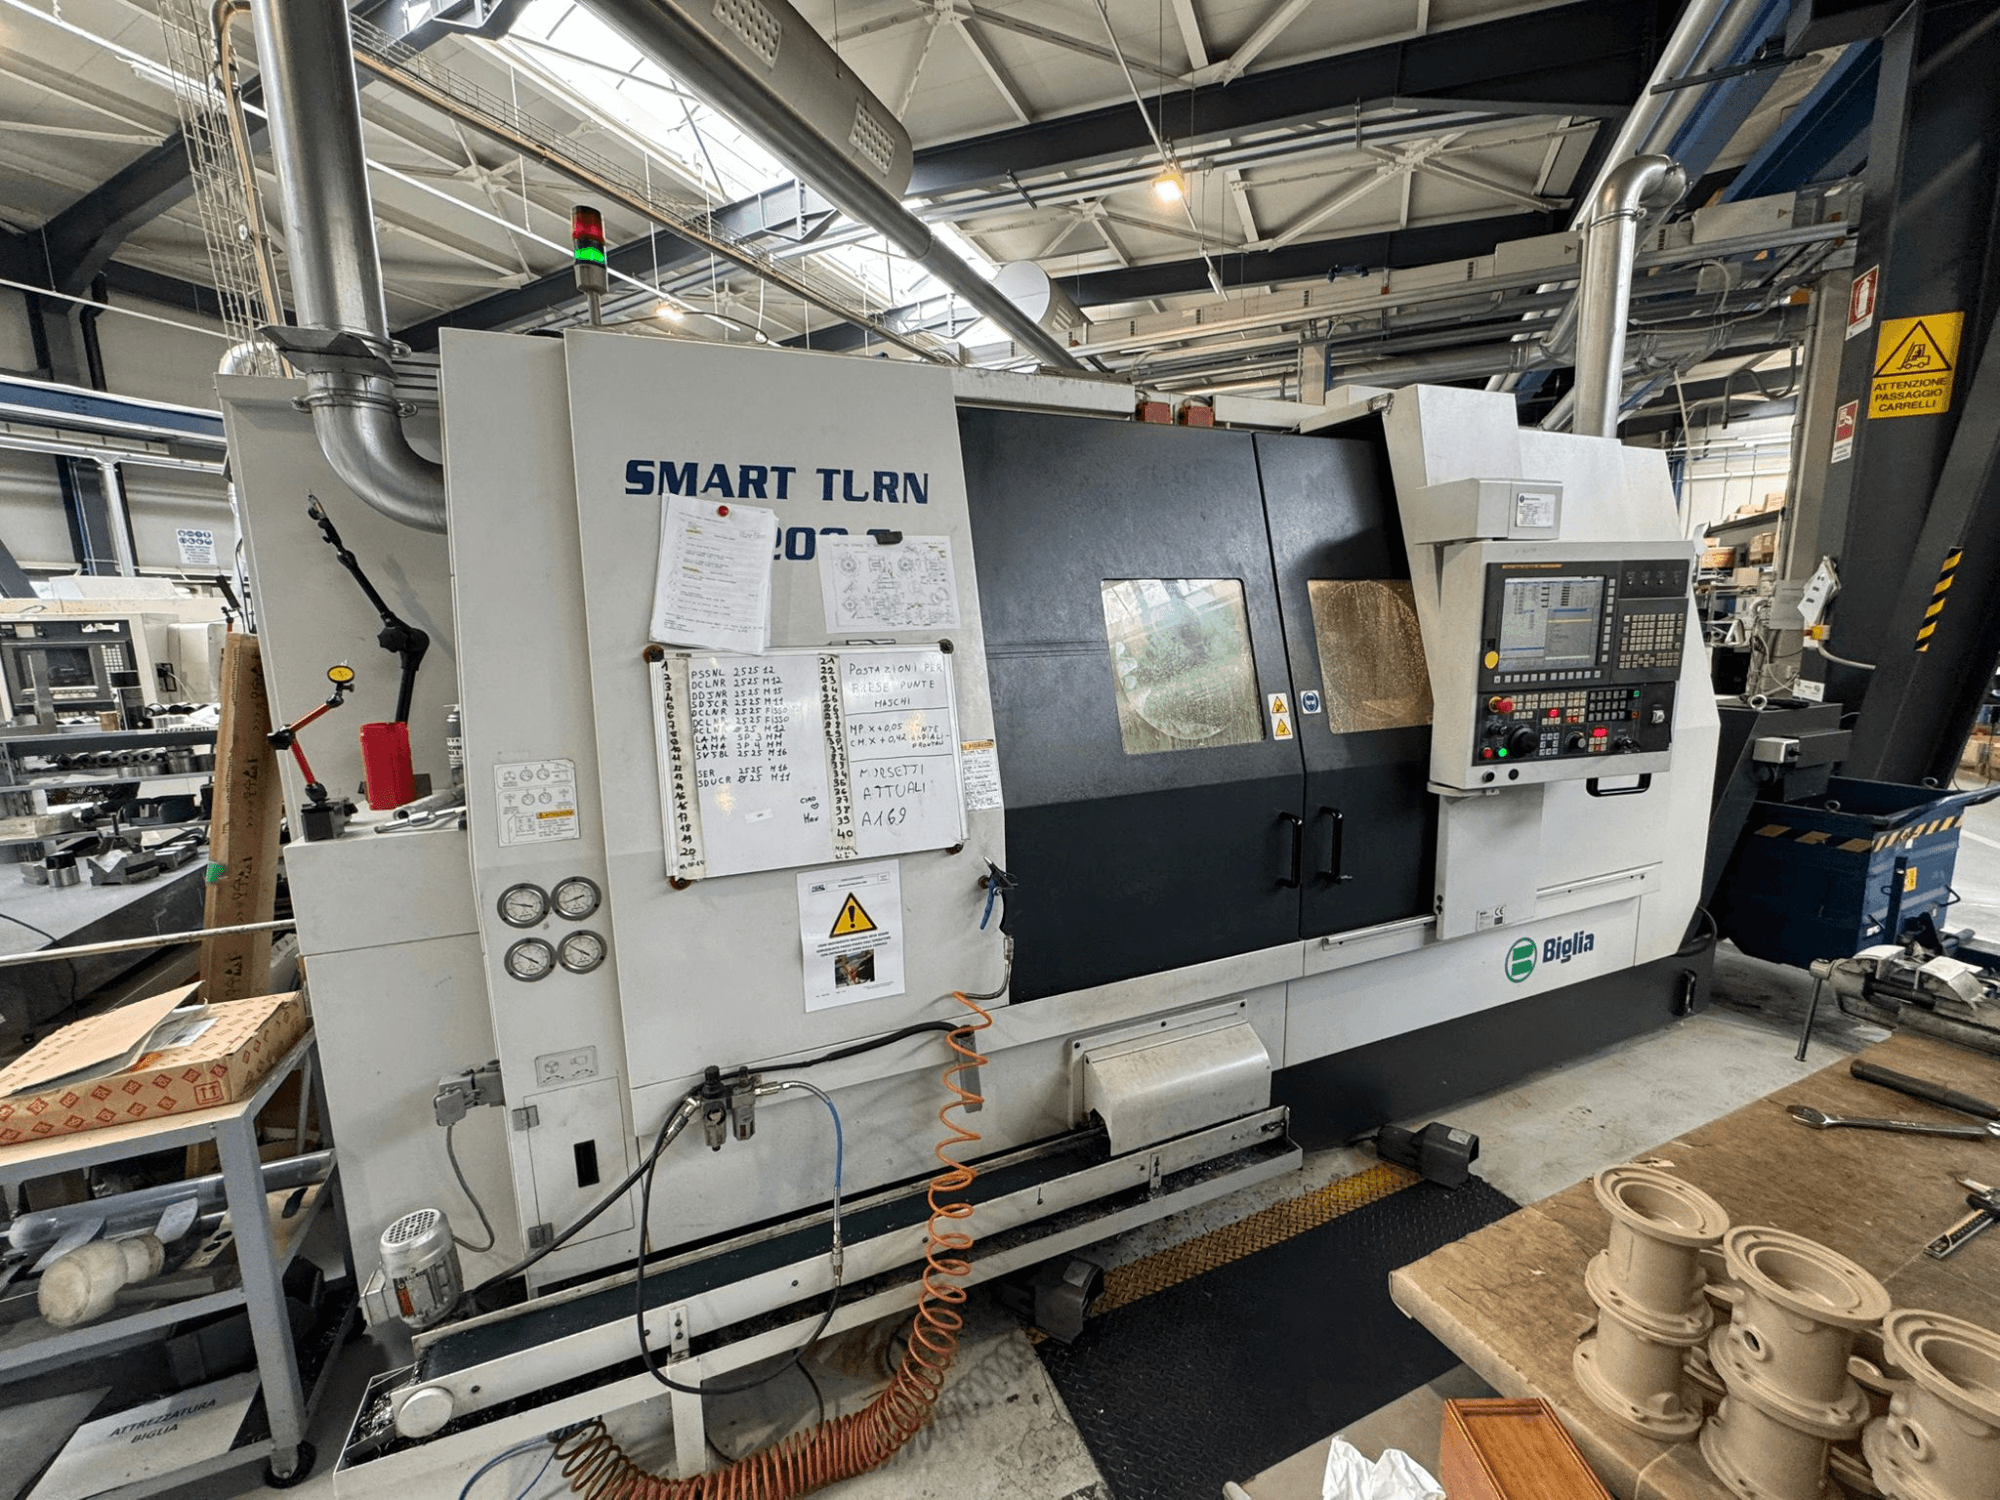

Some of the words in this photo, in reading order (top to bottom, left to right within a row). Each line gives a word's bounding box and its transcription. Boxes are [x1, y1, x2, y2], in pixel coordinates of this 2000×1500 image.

[1874, 377, 1947, 391] ATTENZIONE
[1875, 388, 1943, 401] PASSAGGIO
[1878, 400, 1936, 412] CARRELLI
[625, 460, 797, 500] SMART
[661, 661, 668, 671] 1
[821, 666, 835, 674] 22
[924, 663, 943, 673] PER
[691, 668, 726, 680] PSSNL
[733, 666, 759, 676] 2525
[665, 682, 672, 691] 3
[691, 678, 726, 690] DCLNR
[734, 677, 759, 688] 2525
[901, 680, 935, 690] PUNTE
[666, 693, 673, 702] 4
[734, 688, 760, 698] 2525
[735, 698, 761, 706] 2525
[874, 697, 911, 708] MASCHI
[667, 711, 674, 719] 6
[691, 708, 727, 718] DCLNR
[735, 707, 762, 716] 2525
[736, 716, 762, 726] 2525
[695, 734, 726, 744] LAMA
[696, 742, 726, 752] LAMA
[738, 750, 764, 758] 2525
[698, 768, 715, 778] SER
[739, 766, 763, 775] 2525
[698, 776, 732, 788] SDUCR
[863, 781, 926, 800] ATTUALI
[836, 806, 850, 816] 38
[838, 816, 850, 826] 39
[862, 806, 906, 827] A169
[680, 824, 691, 832] 18
[837, 828, 854, 839] 40
[680, 848, 696, 856] 20
[1542, 930, 1594, 964] Biglia
[109, 1399, 216, 1438] ATTREZZATURA
[131, 1424, 178, 1444] BIGLIA
